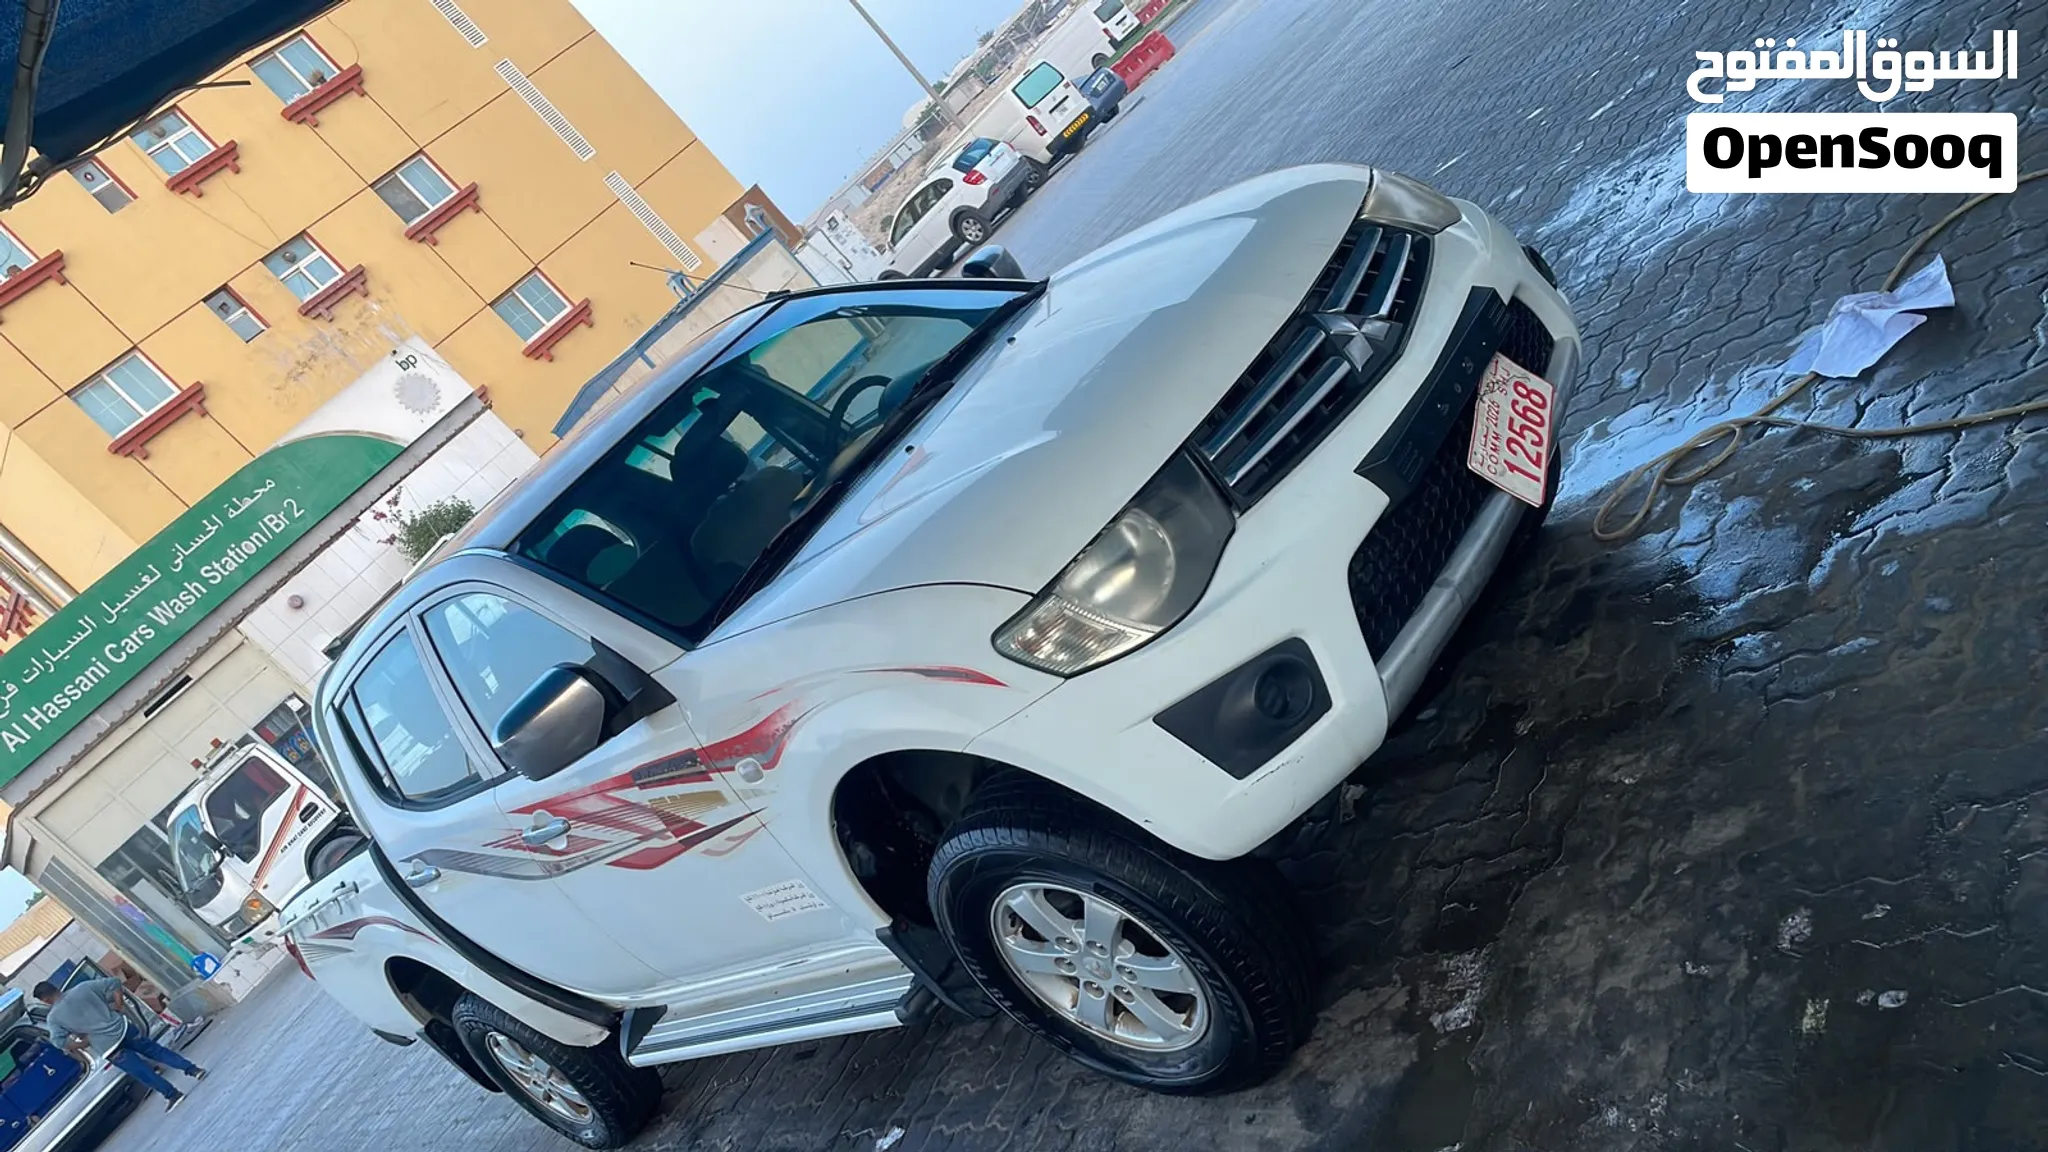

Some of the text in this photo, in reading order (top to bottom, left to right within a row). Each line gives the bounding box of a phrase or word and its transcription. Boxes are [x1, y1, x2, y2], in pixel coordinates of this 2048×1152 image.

[395, 353, 418, 371] bp
[1498, 366, 1511, 396] SHJ
[1485, 399, 1502, 475] COMM 2026
[1502, 379, 1548, 483] 12568
[223, 478, 276, 519] محطة
[1, 722, 32, 754] Al
[22, 656, 111, 731] Hassani
[104, 624, 156, 664] Cars
[146, 581, 208, 627] Wash
[283, 498, 306, 519] 2
[101, 564, 162, 624] لغسيل
[21, 614, 98, 685] السيارات
